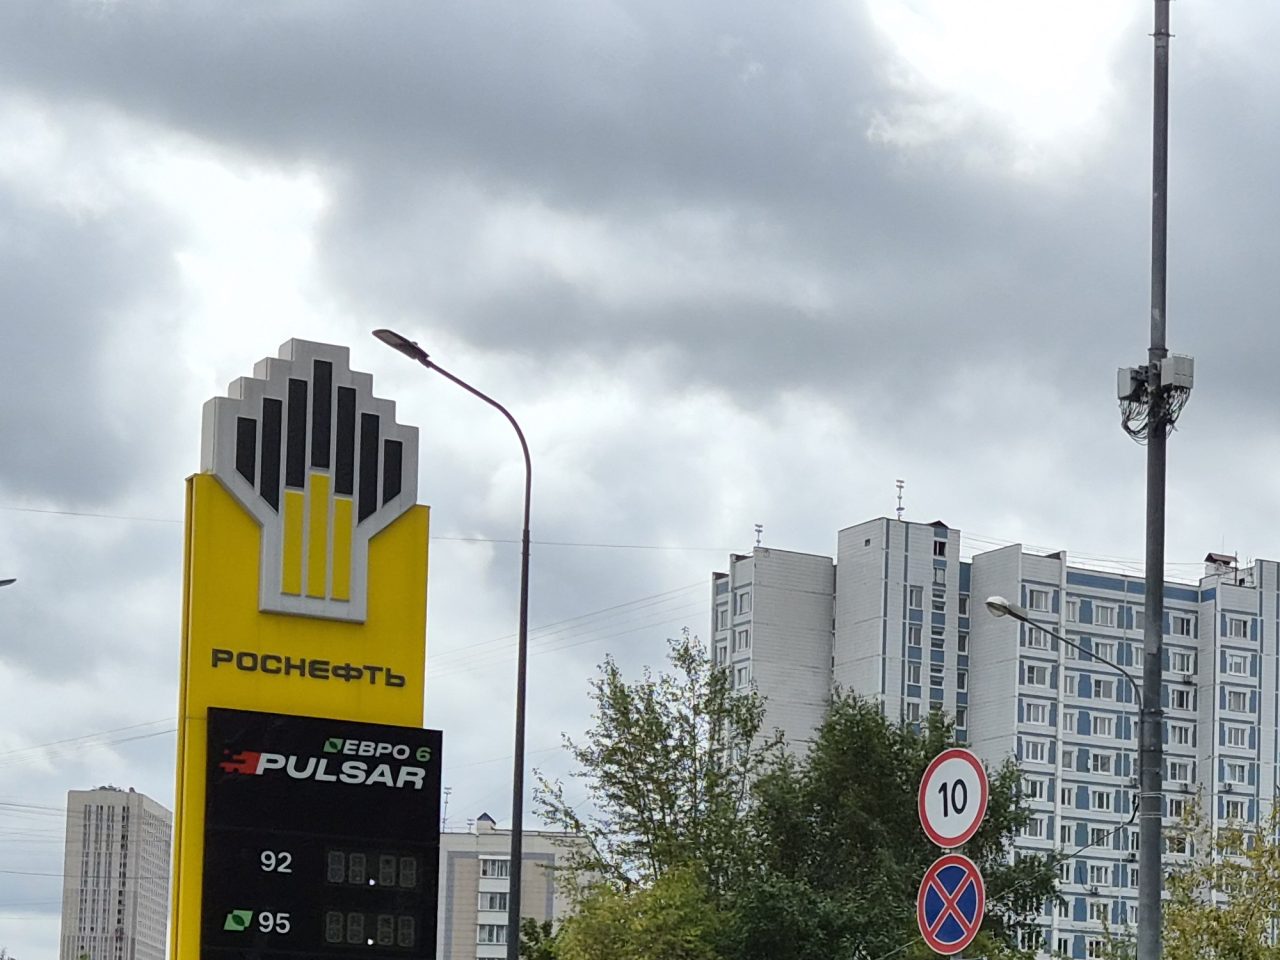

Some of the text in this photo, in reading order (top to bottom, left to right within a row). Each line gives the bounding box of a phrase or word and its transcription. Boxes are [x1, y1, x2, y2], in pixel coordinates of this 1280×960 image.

[211, 648, 405, 688] РОСНЕФТЬ
[343, 739, 431, 762] ЕВРО 6
[255, 752, 426, 789] PULSAR
[938, 778, 968, 818] 10
[260, 850, 293, 873] 92
[258, 911, 290, 933] 95
